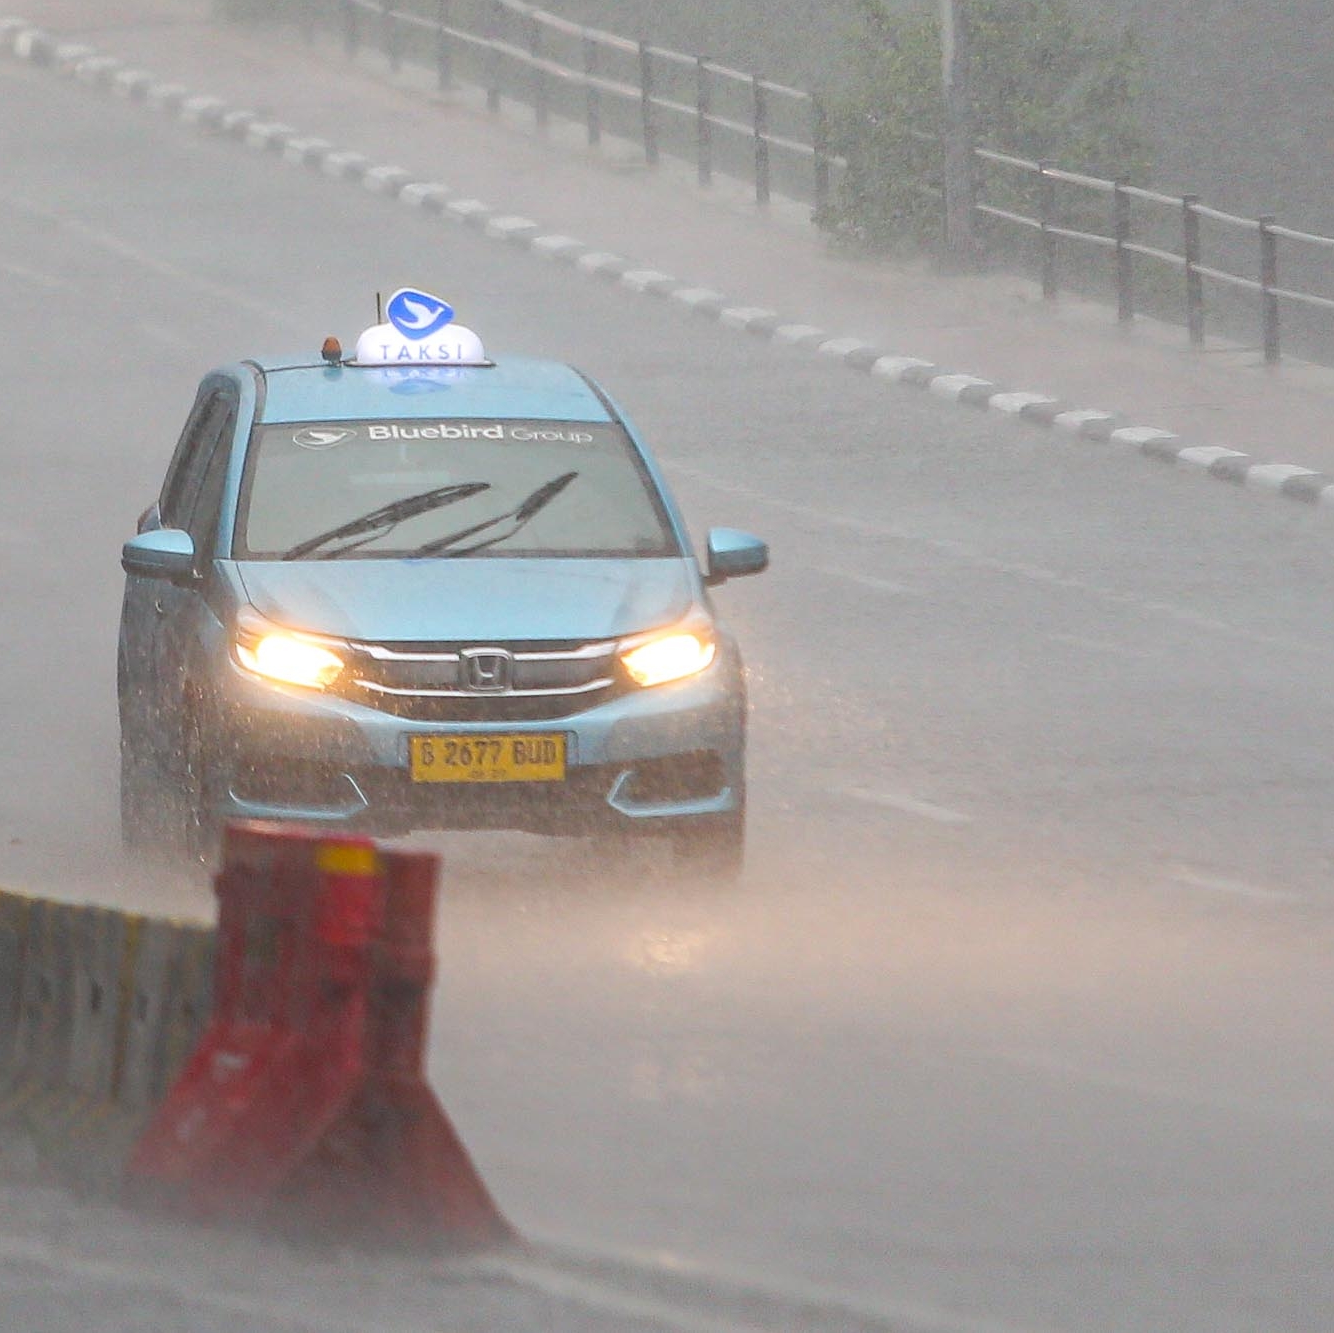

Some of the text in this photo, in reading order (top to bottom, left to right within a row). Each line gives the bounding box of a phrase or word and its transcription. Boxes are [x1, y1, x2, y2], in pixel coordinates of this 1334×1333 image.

[380, 344, 462, 360] TAKSI
[368, 424, 594, 443] Bluebird Group
[422, 740, 557, 765] B 2677 BUD
